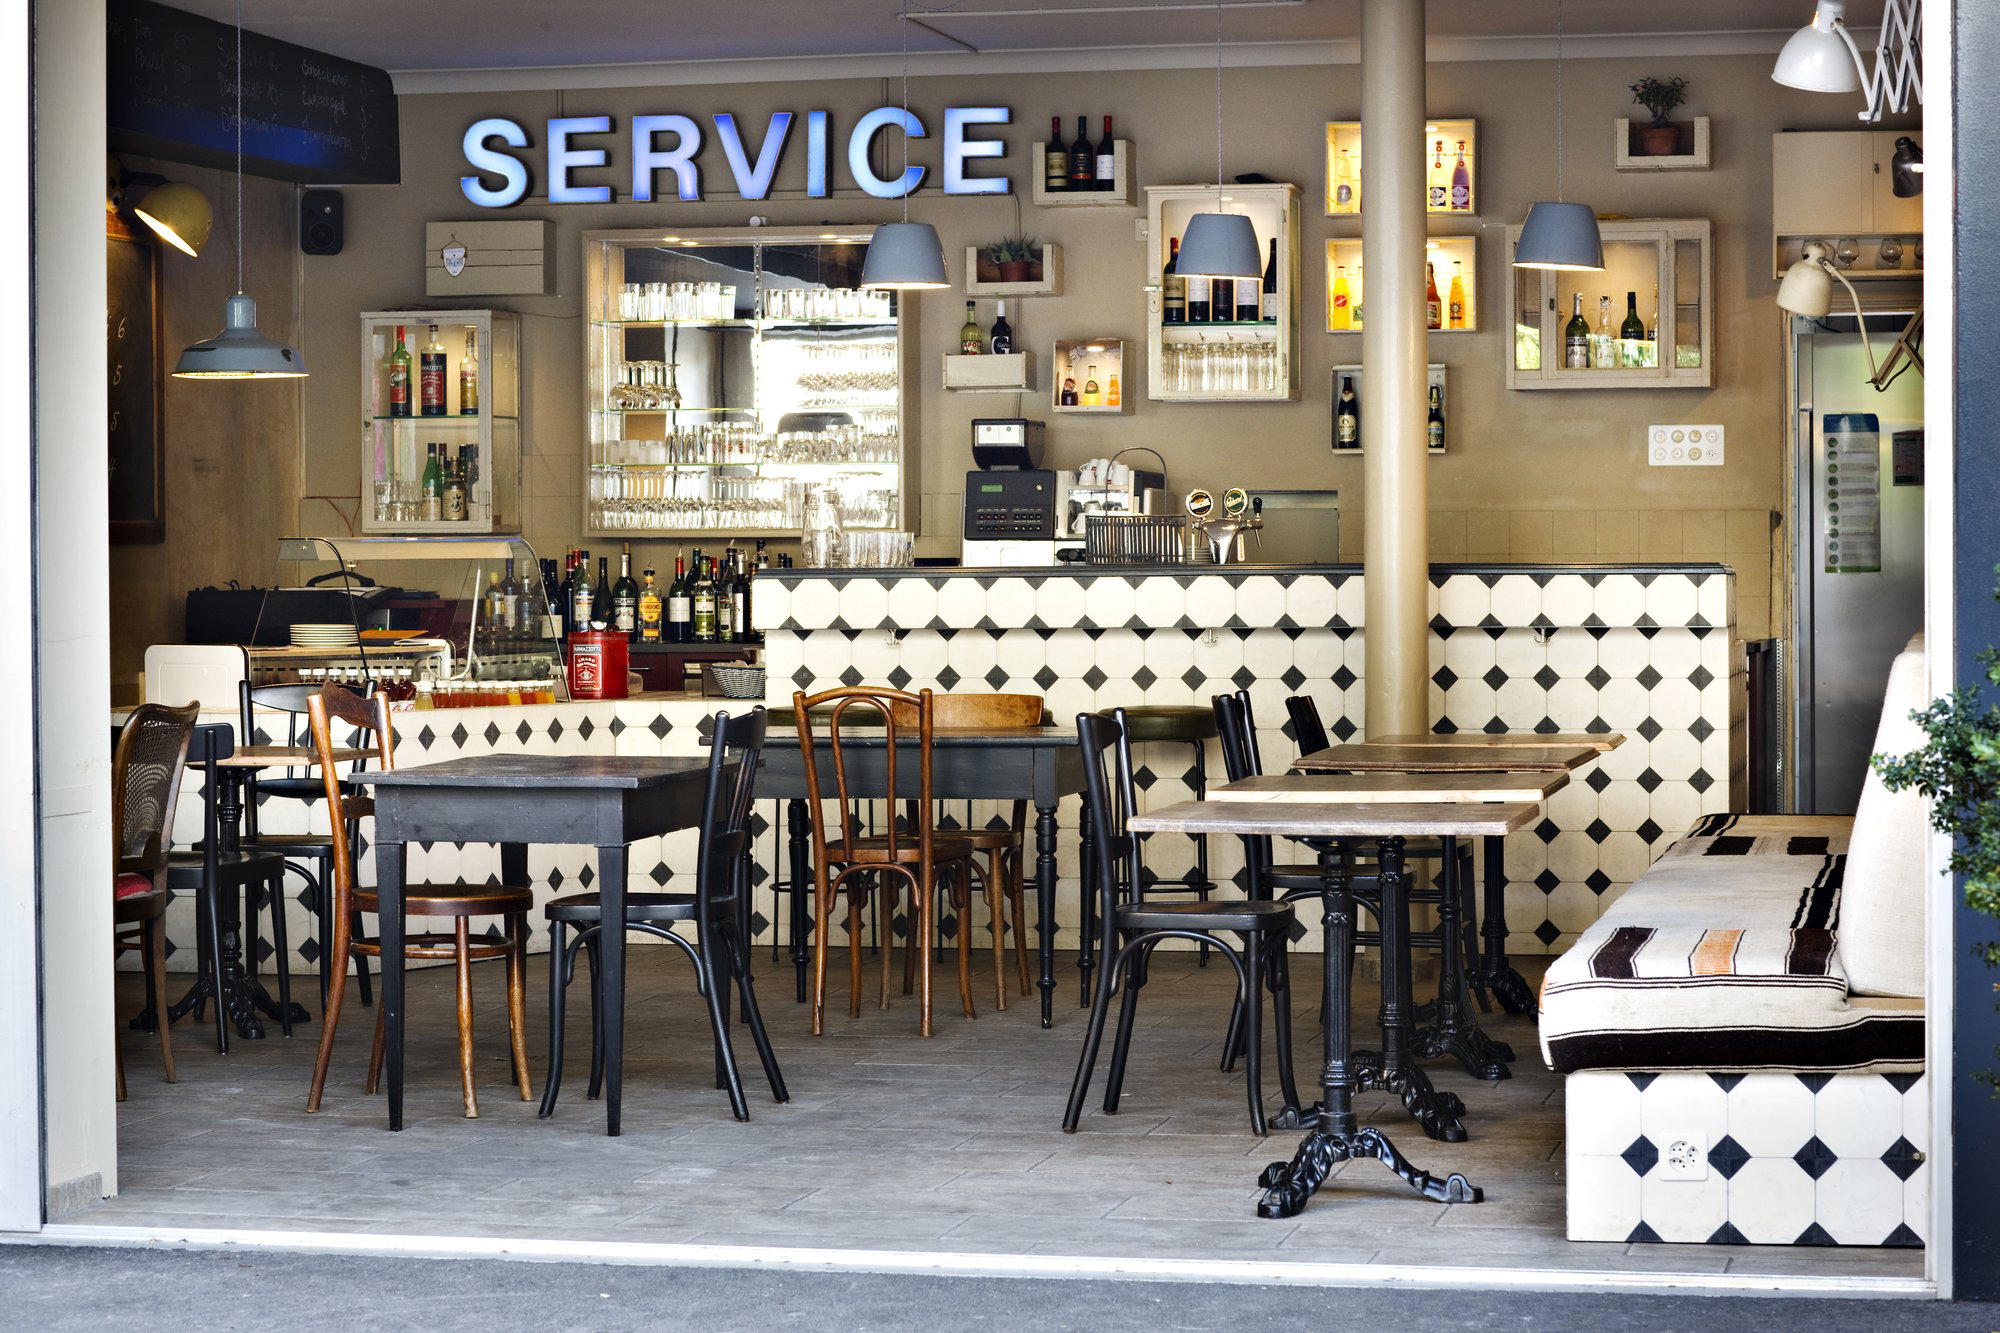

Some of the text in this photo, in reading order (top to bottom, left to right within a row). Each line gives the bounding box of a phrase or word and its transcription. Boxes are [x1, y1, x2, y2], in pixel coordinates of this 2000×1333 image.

[461, 107, 1011, 208] SERVICE
[117, 316, 126, 339] 6
[112, 364, 122, 386] 5
[110, 410, 120, 432] 5
